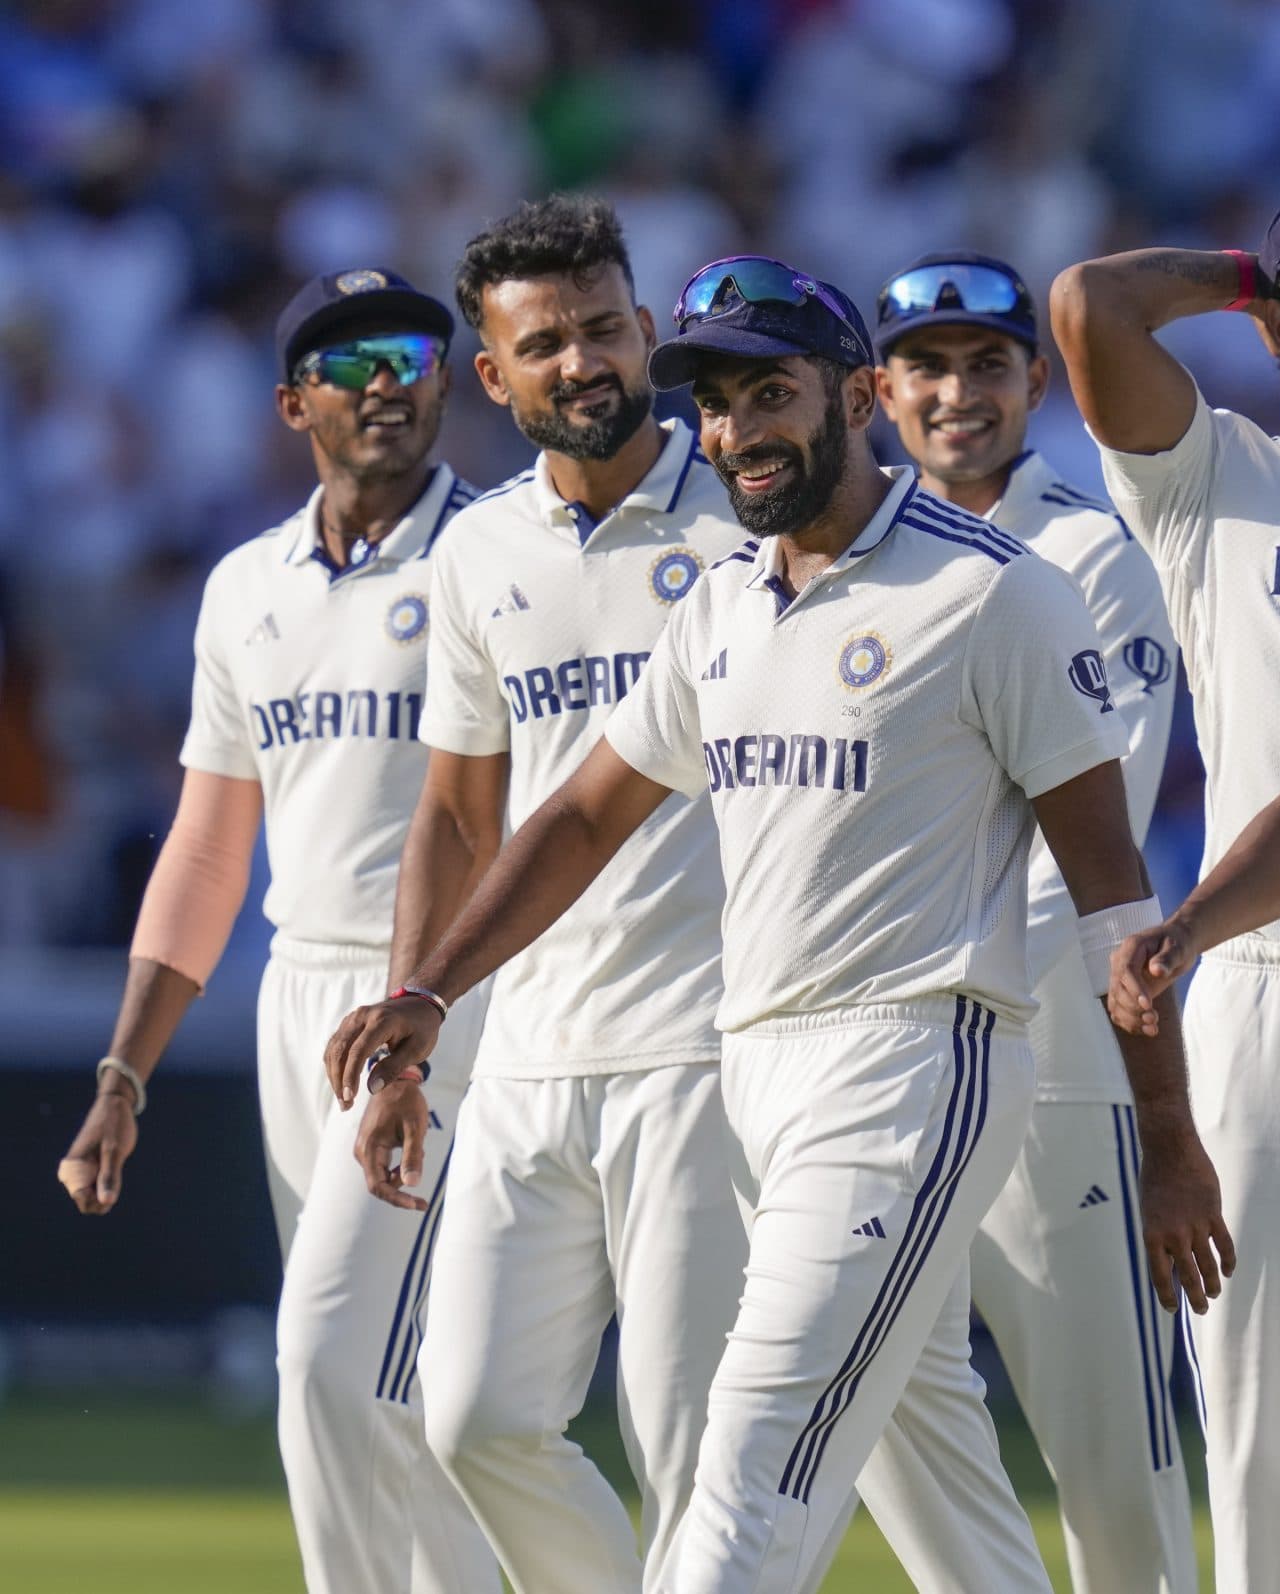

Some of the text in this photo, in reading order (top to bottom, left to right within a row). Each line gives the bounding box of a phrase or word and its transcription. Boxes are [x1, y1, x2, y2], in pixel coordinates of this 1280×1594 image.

[839, 335, 857, 352] 290
[841, 704, 861, 718] 290
[702, 733, 869, 793] DREAM11
